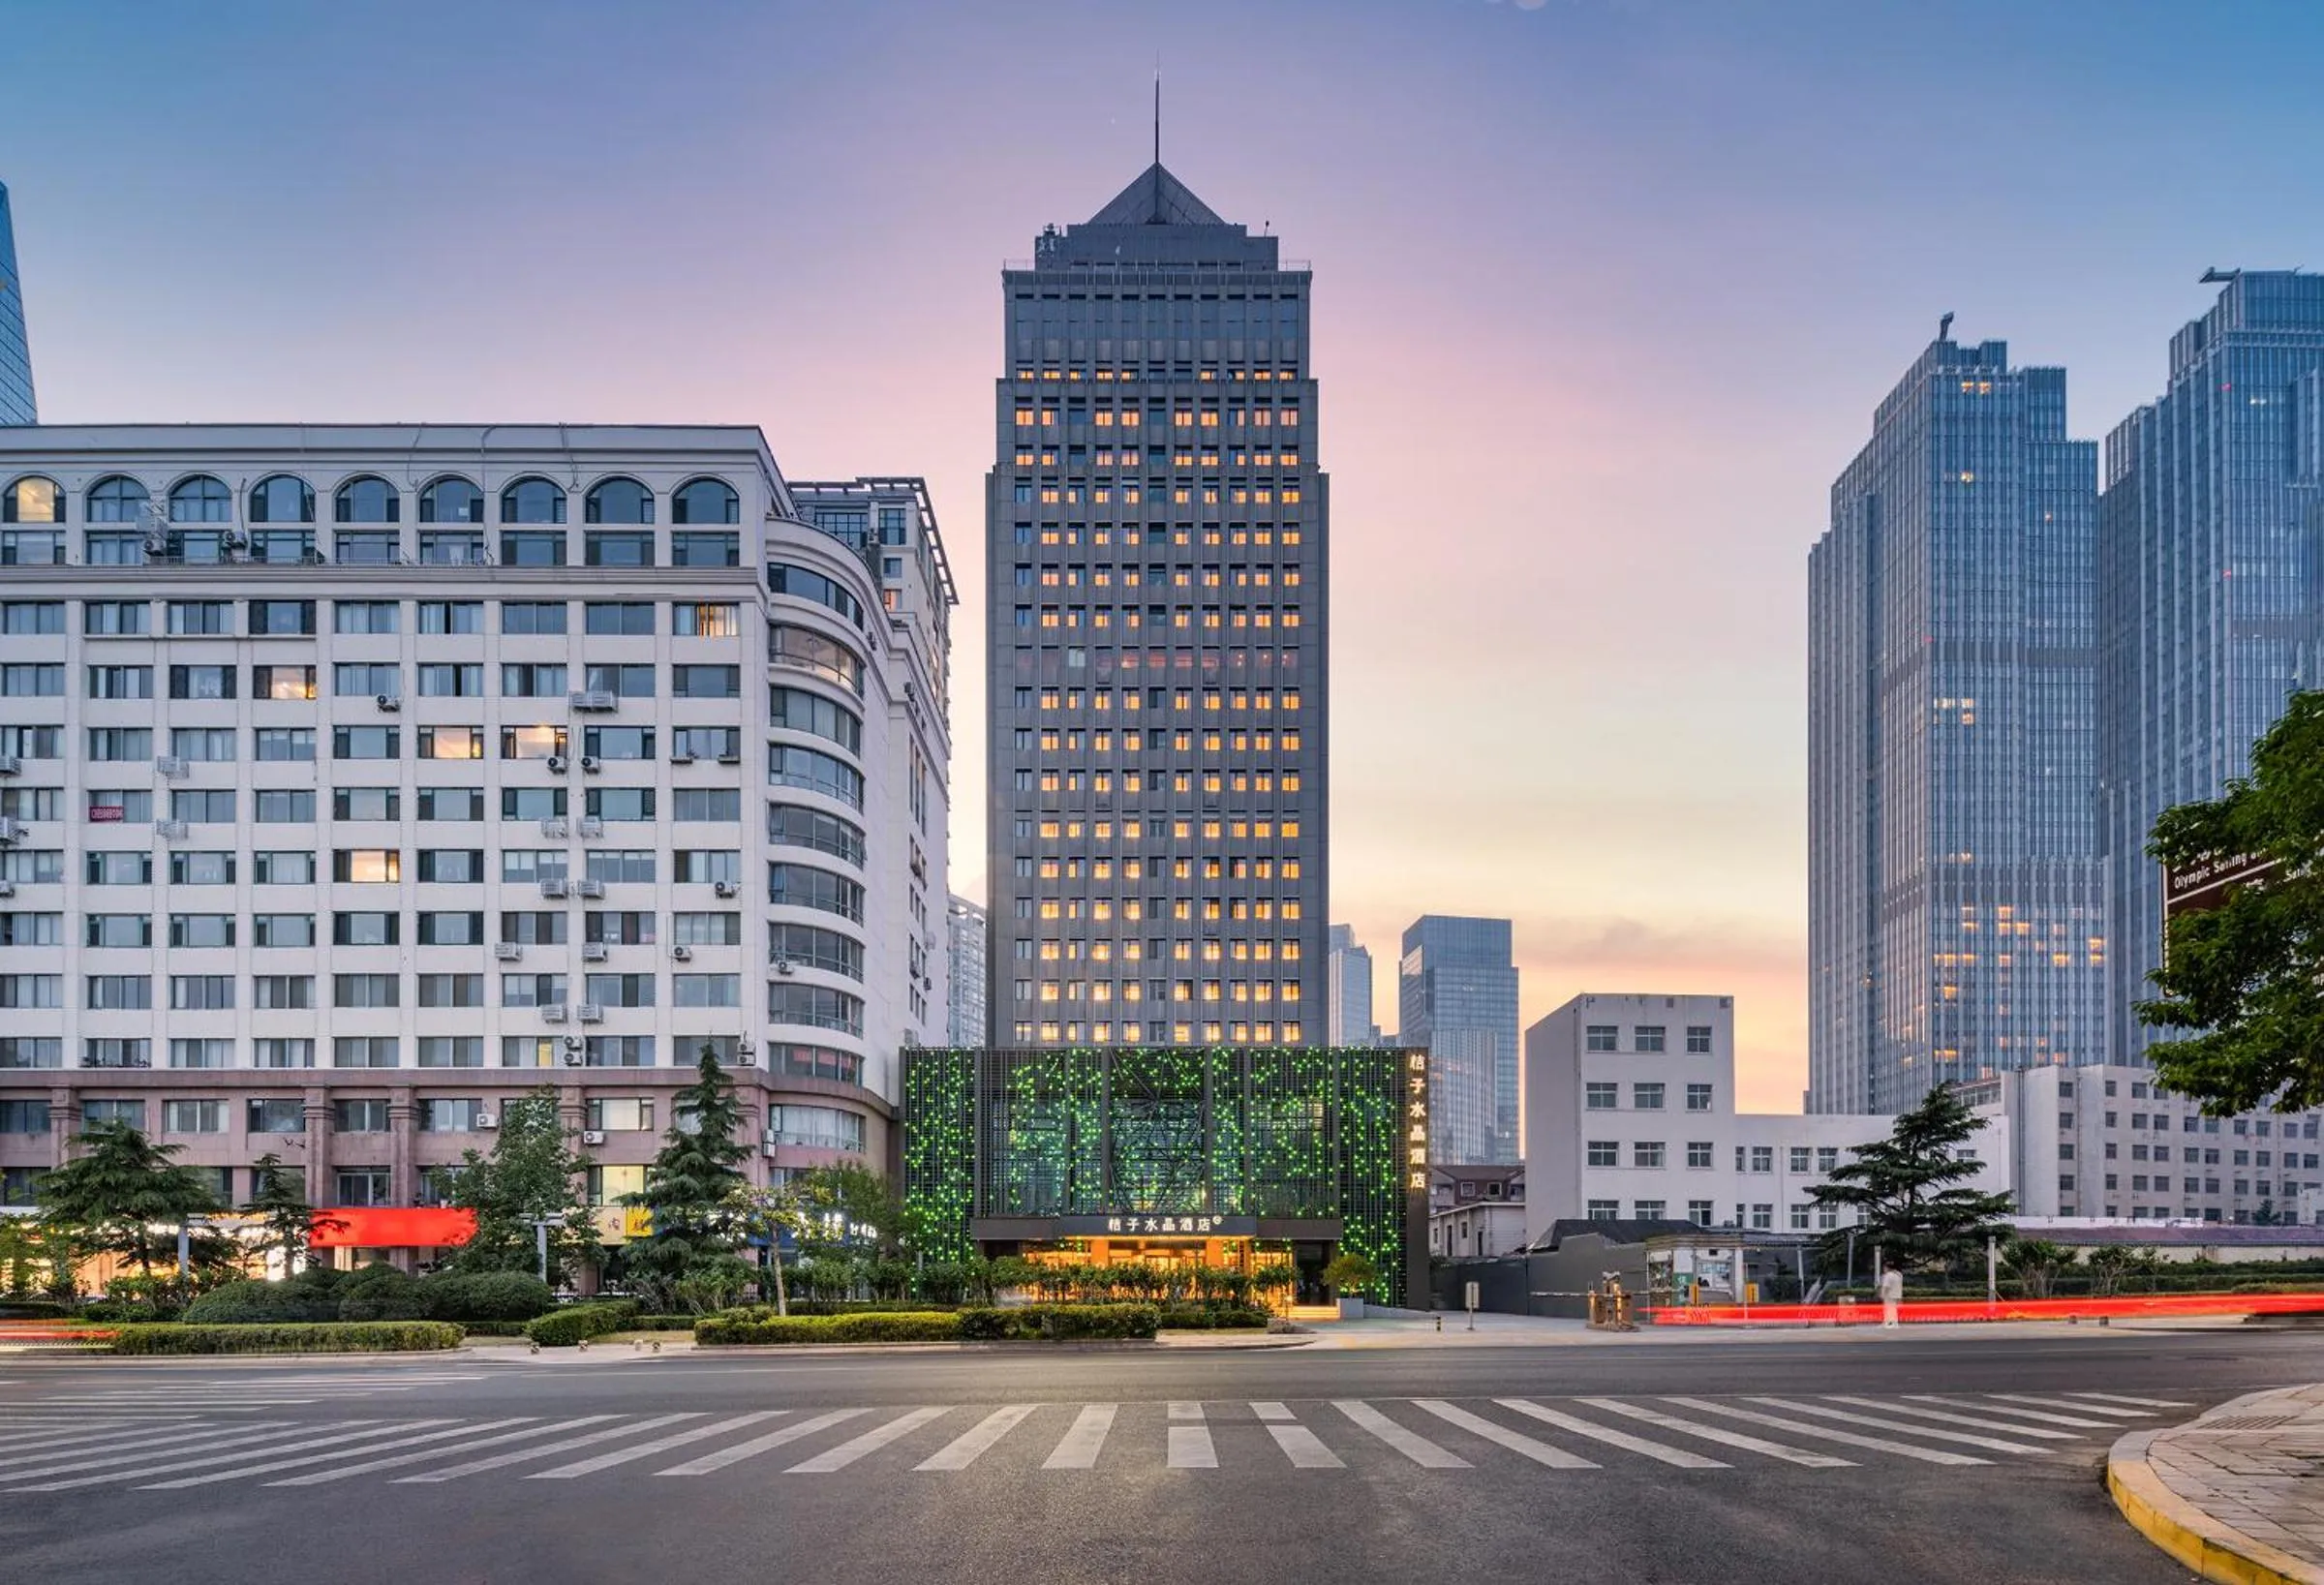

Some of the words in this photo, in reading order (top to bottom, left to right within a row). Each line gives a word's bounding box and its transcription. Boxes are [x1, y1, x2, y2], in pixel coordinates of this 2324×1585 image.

[2174, 867, 2211, 890] Olympic
[1409, 1053, 1426, 1189] 桔子水晶酒店
[1108, 1217, 1210, 1232] 桔子水晶酒店
